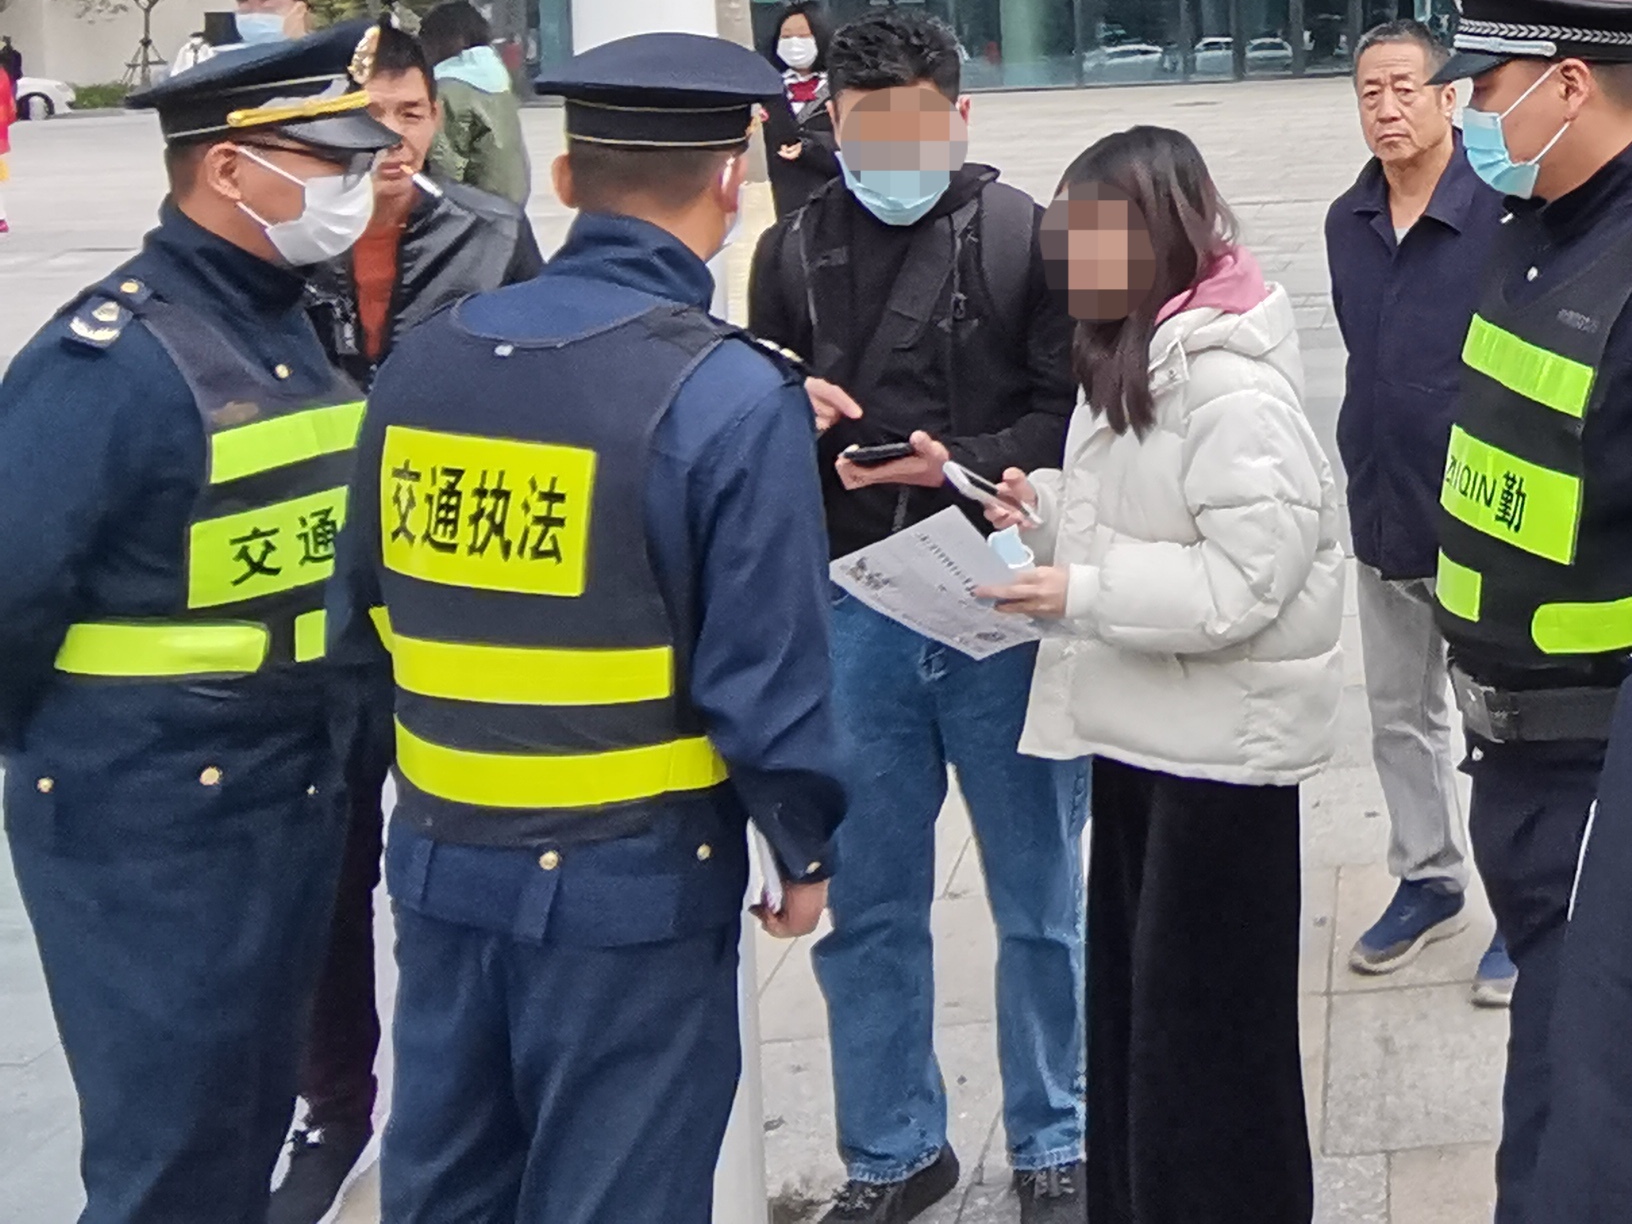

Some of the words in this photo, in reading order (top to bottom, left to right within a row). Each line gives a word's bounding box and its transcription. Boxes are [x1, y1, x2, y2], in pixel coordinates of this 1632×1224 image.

[391, 458, 567, 565] 交通执法
[1494, 470, 1527, 533] 勤
[229, 506, 338, 587] 交通
